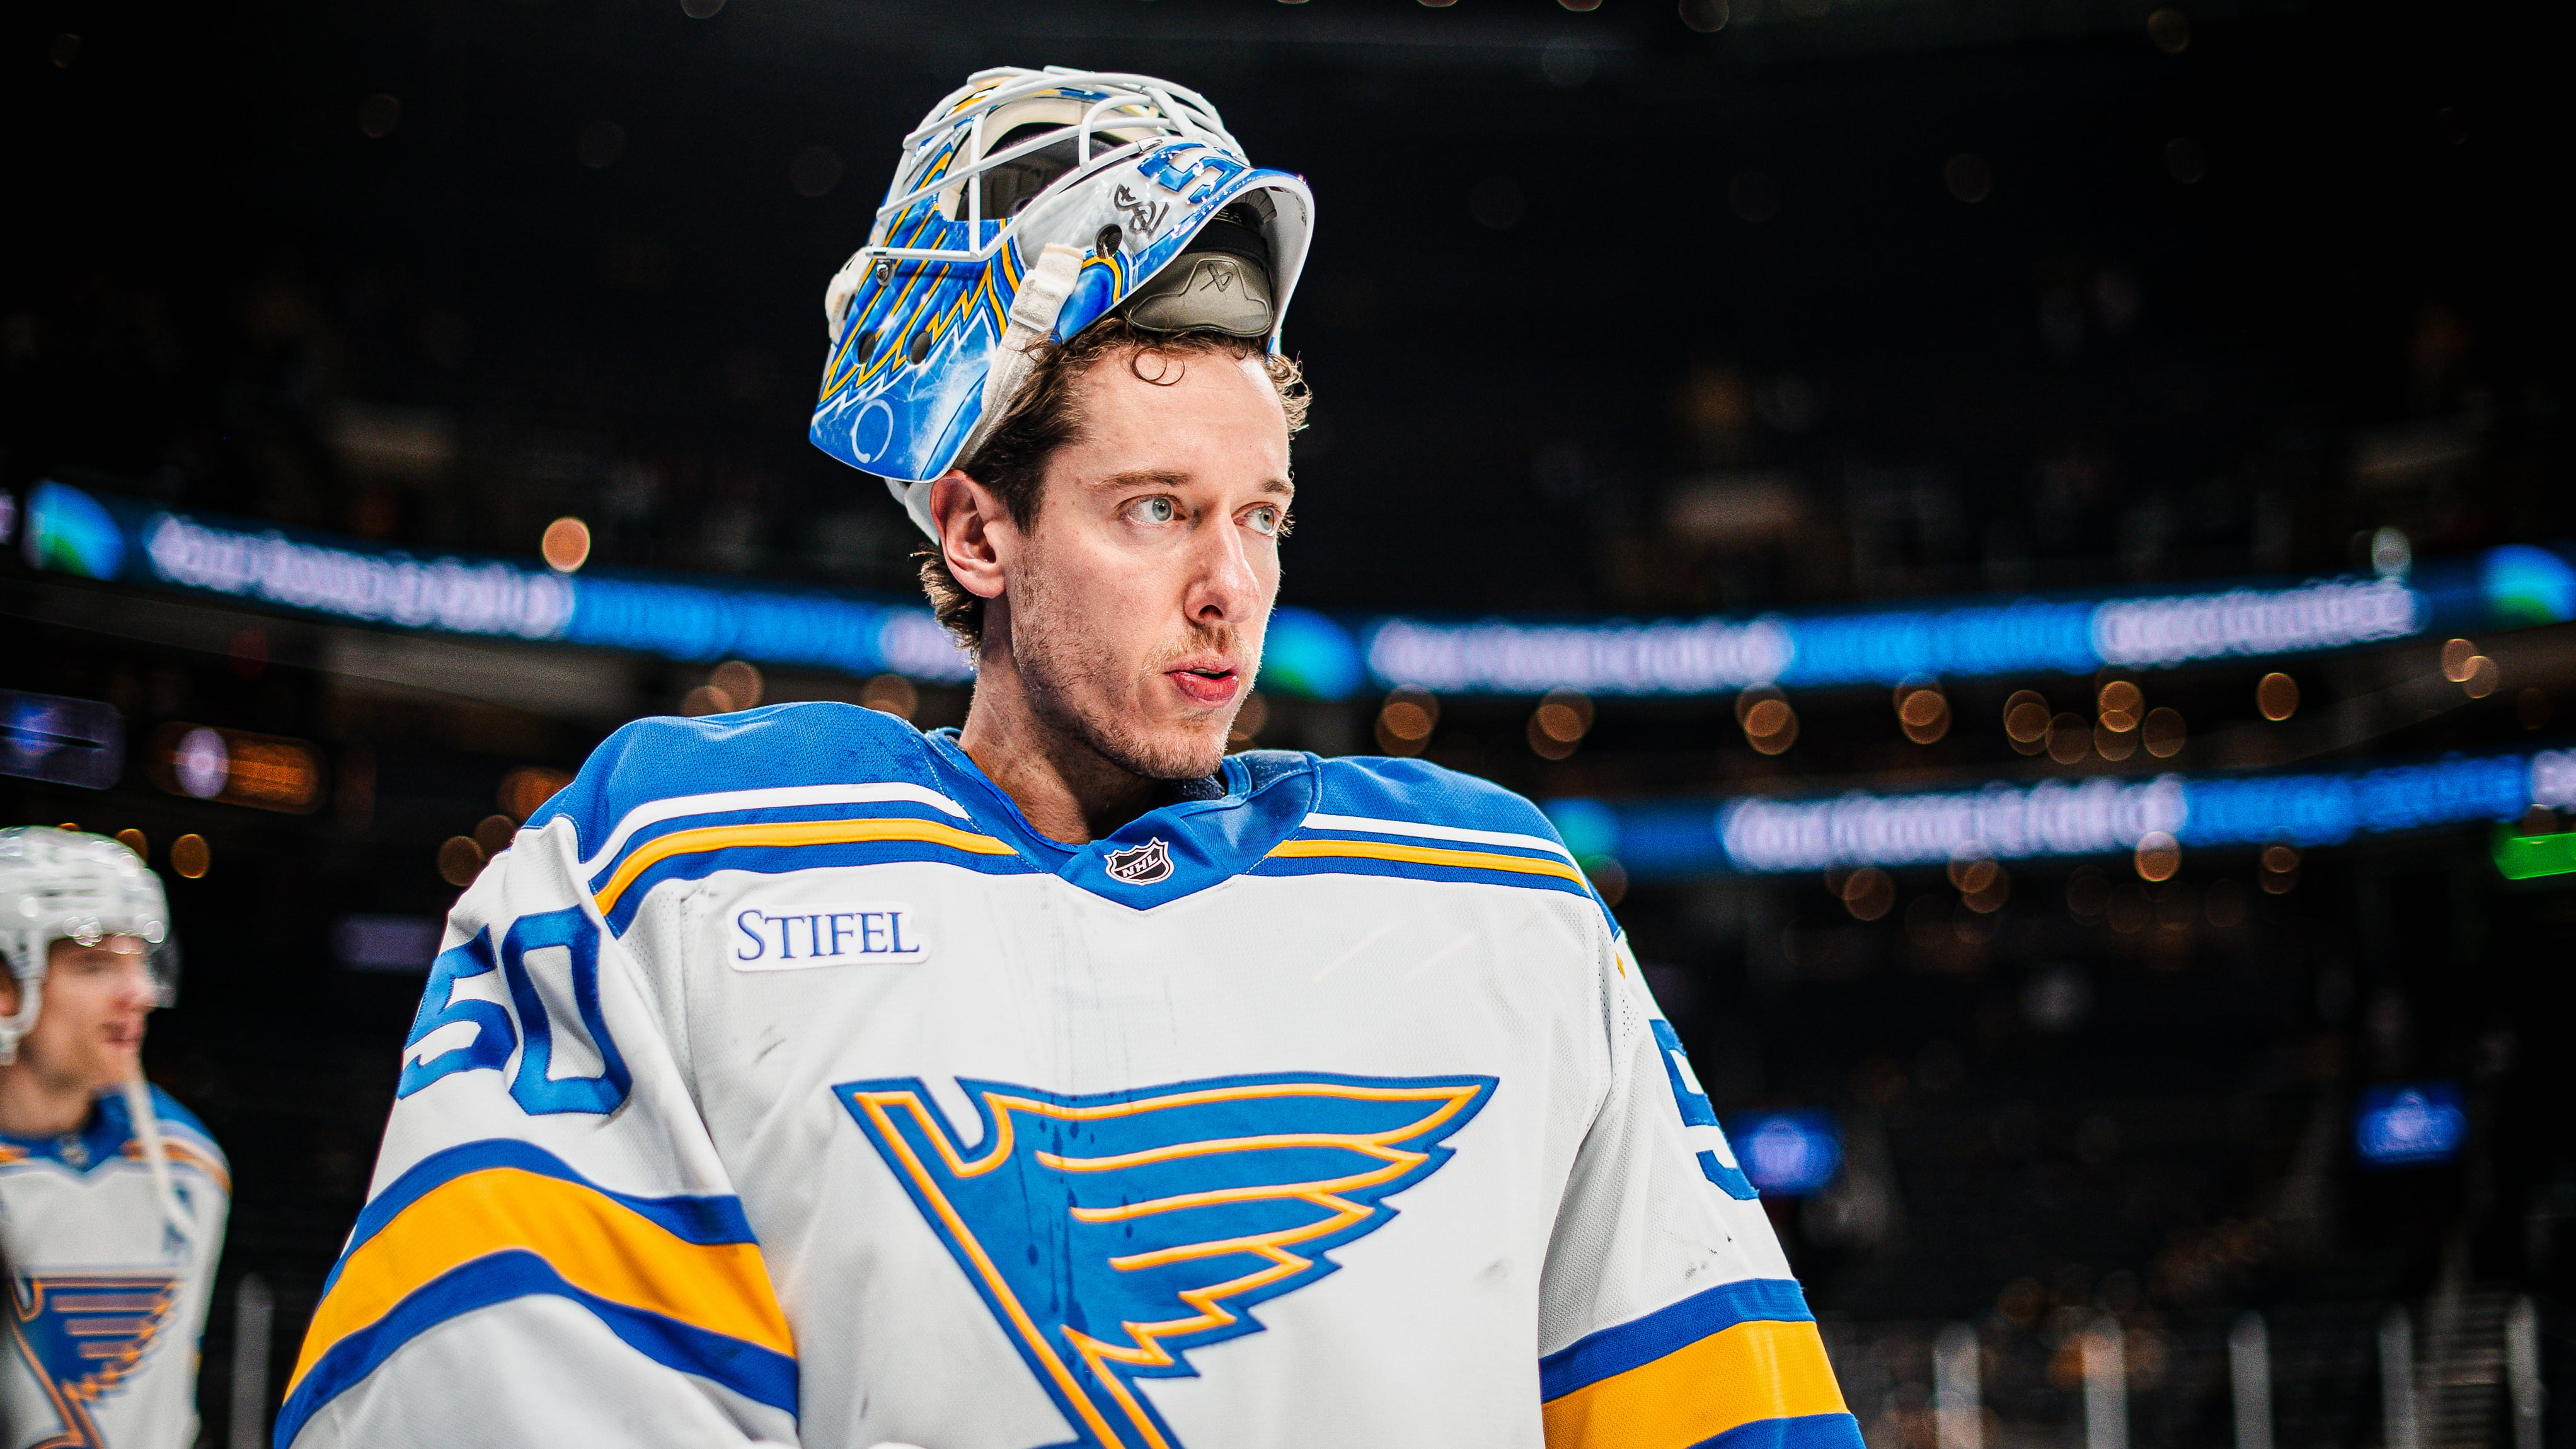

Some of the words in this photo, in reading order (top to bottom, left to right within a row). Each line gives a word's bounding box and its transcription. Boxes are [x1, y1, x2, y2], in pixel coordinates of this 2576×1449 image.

[1122, 855, 1158, 877] NHL
[737, 909, 920, 961] STIFEL
[396, 903, 633, 1116] 50
